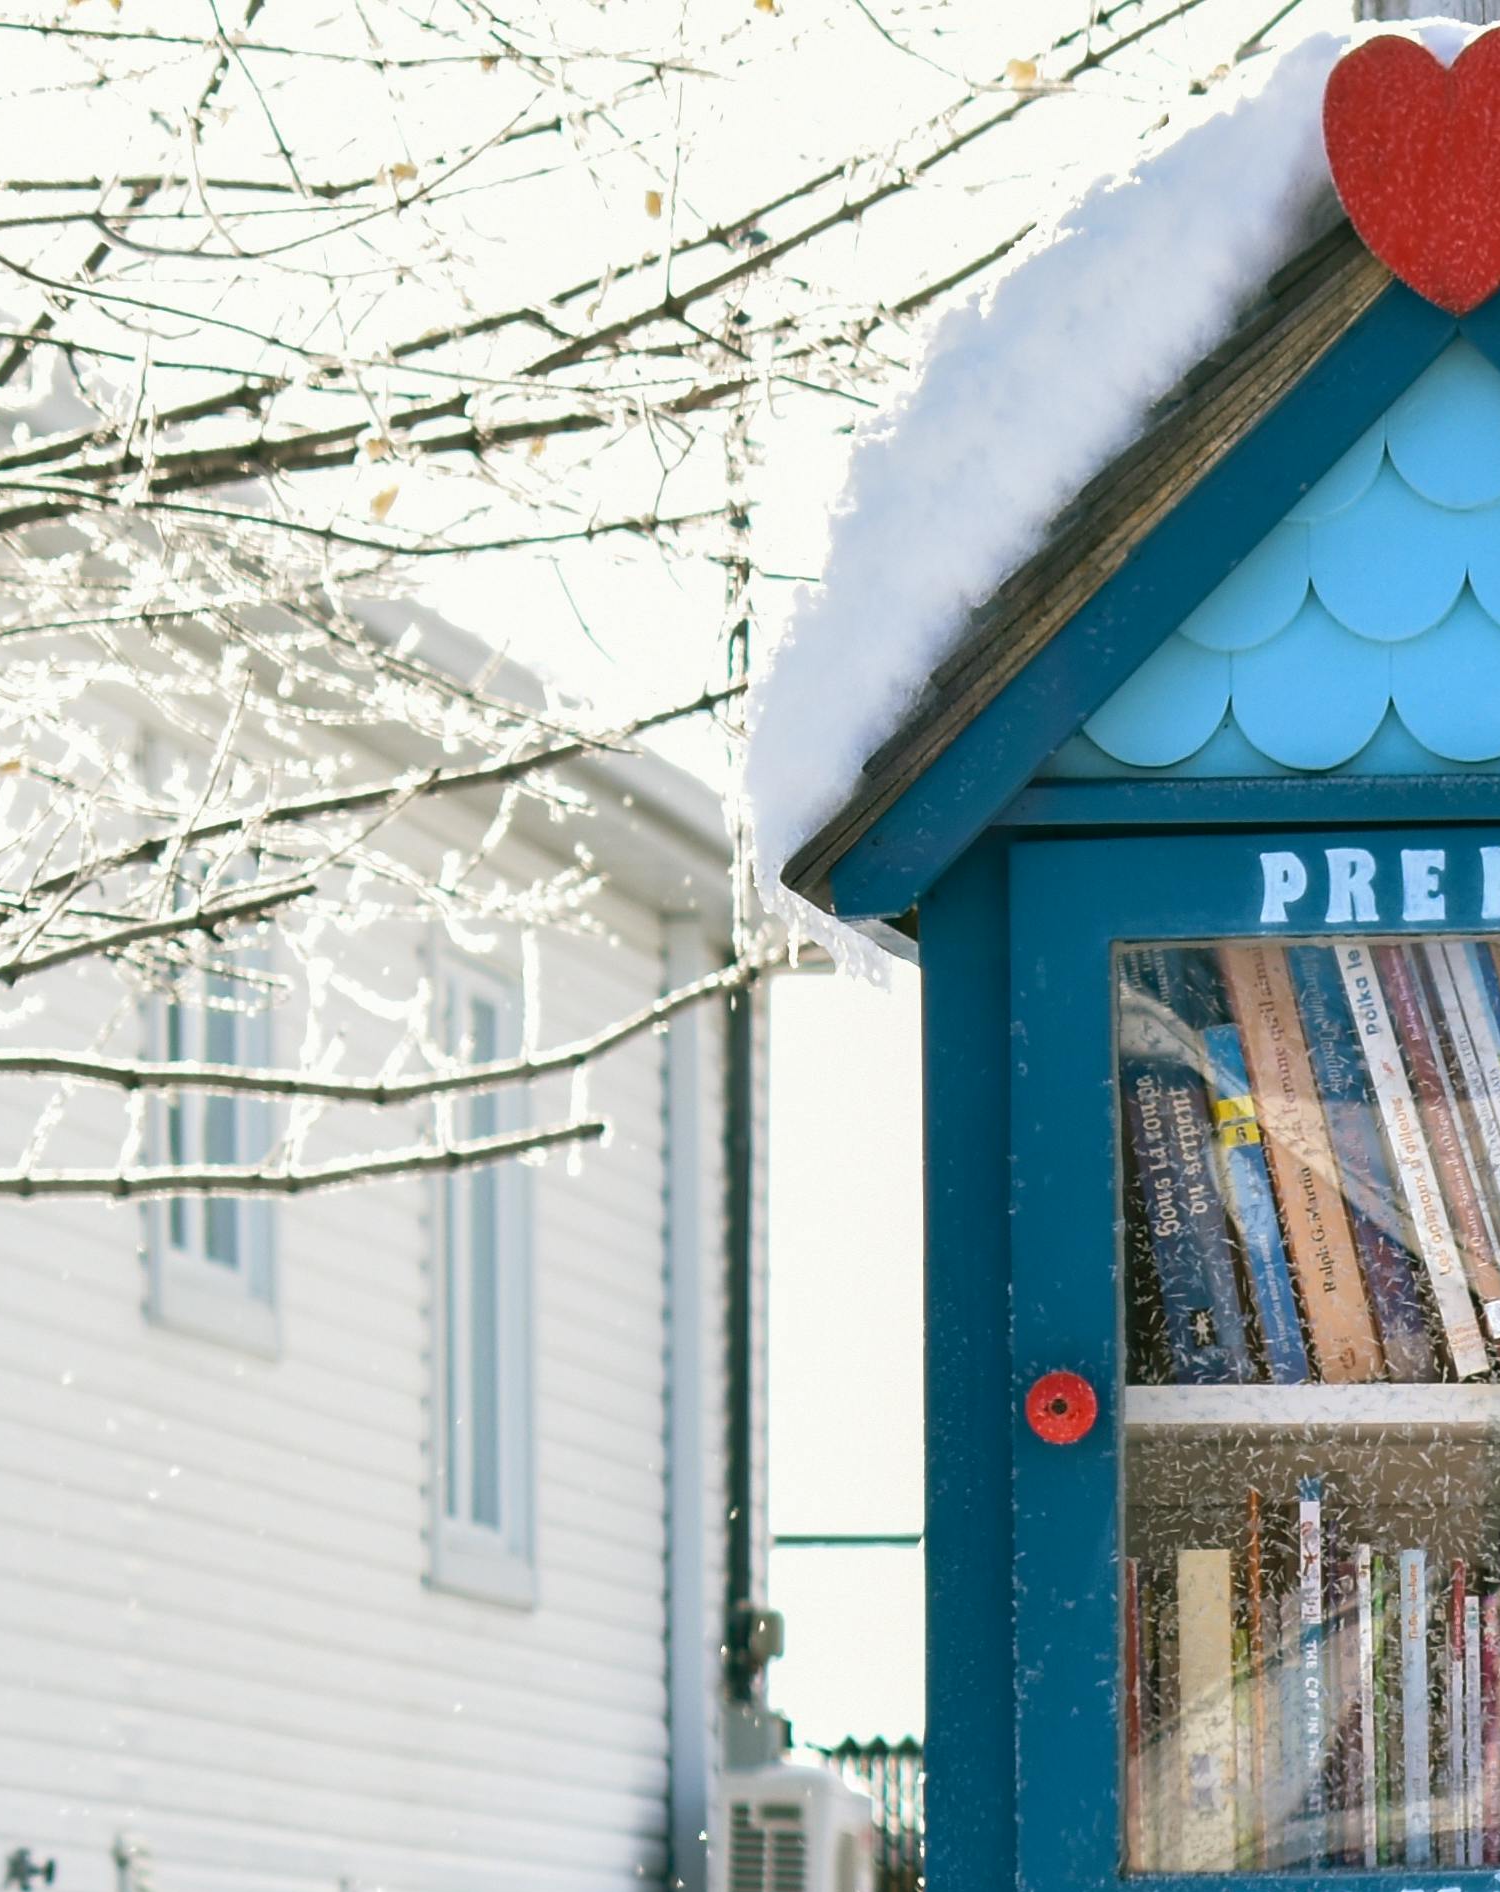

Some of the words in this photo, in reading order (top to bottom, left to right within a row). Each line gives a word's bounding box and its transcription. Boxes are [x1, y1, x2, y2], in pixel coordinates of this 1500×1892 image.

[1347, 949, 1363, 970] le
[1356, 977, 1381, 1035] Polka
[1276, 1045, 1297, 1115] Femme
[1167, 1086, 1204, 1176] serpent
[1390, 1095, 1418, 1169] d'ailleurs
[1151, 1178, 1181, 1238] Sous
[1301, 1166, 1321, 1221] Martin
[1414, 1173, 1443, 1244] animaux
[1311, 1225, 1325, 1242] G.
[1466, 1207, 1486, 1247] Quatre
[1316, 1245, 1336, 1293] Ralph
[1437, 1248, 1451, 1276] Les
[1305, 1640, 1318, 1669] THE
[1306, 1716, 1319, 1733] IN
